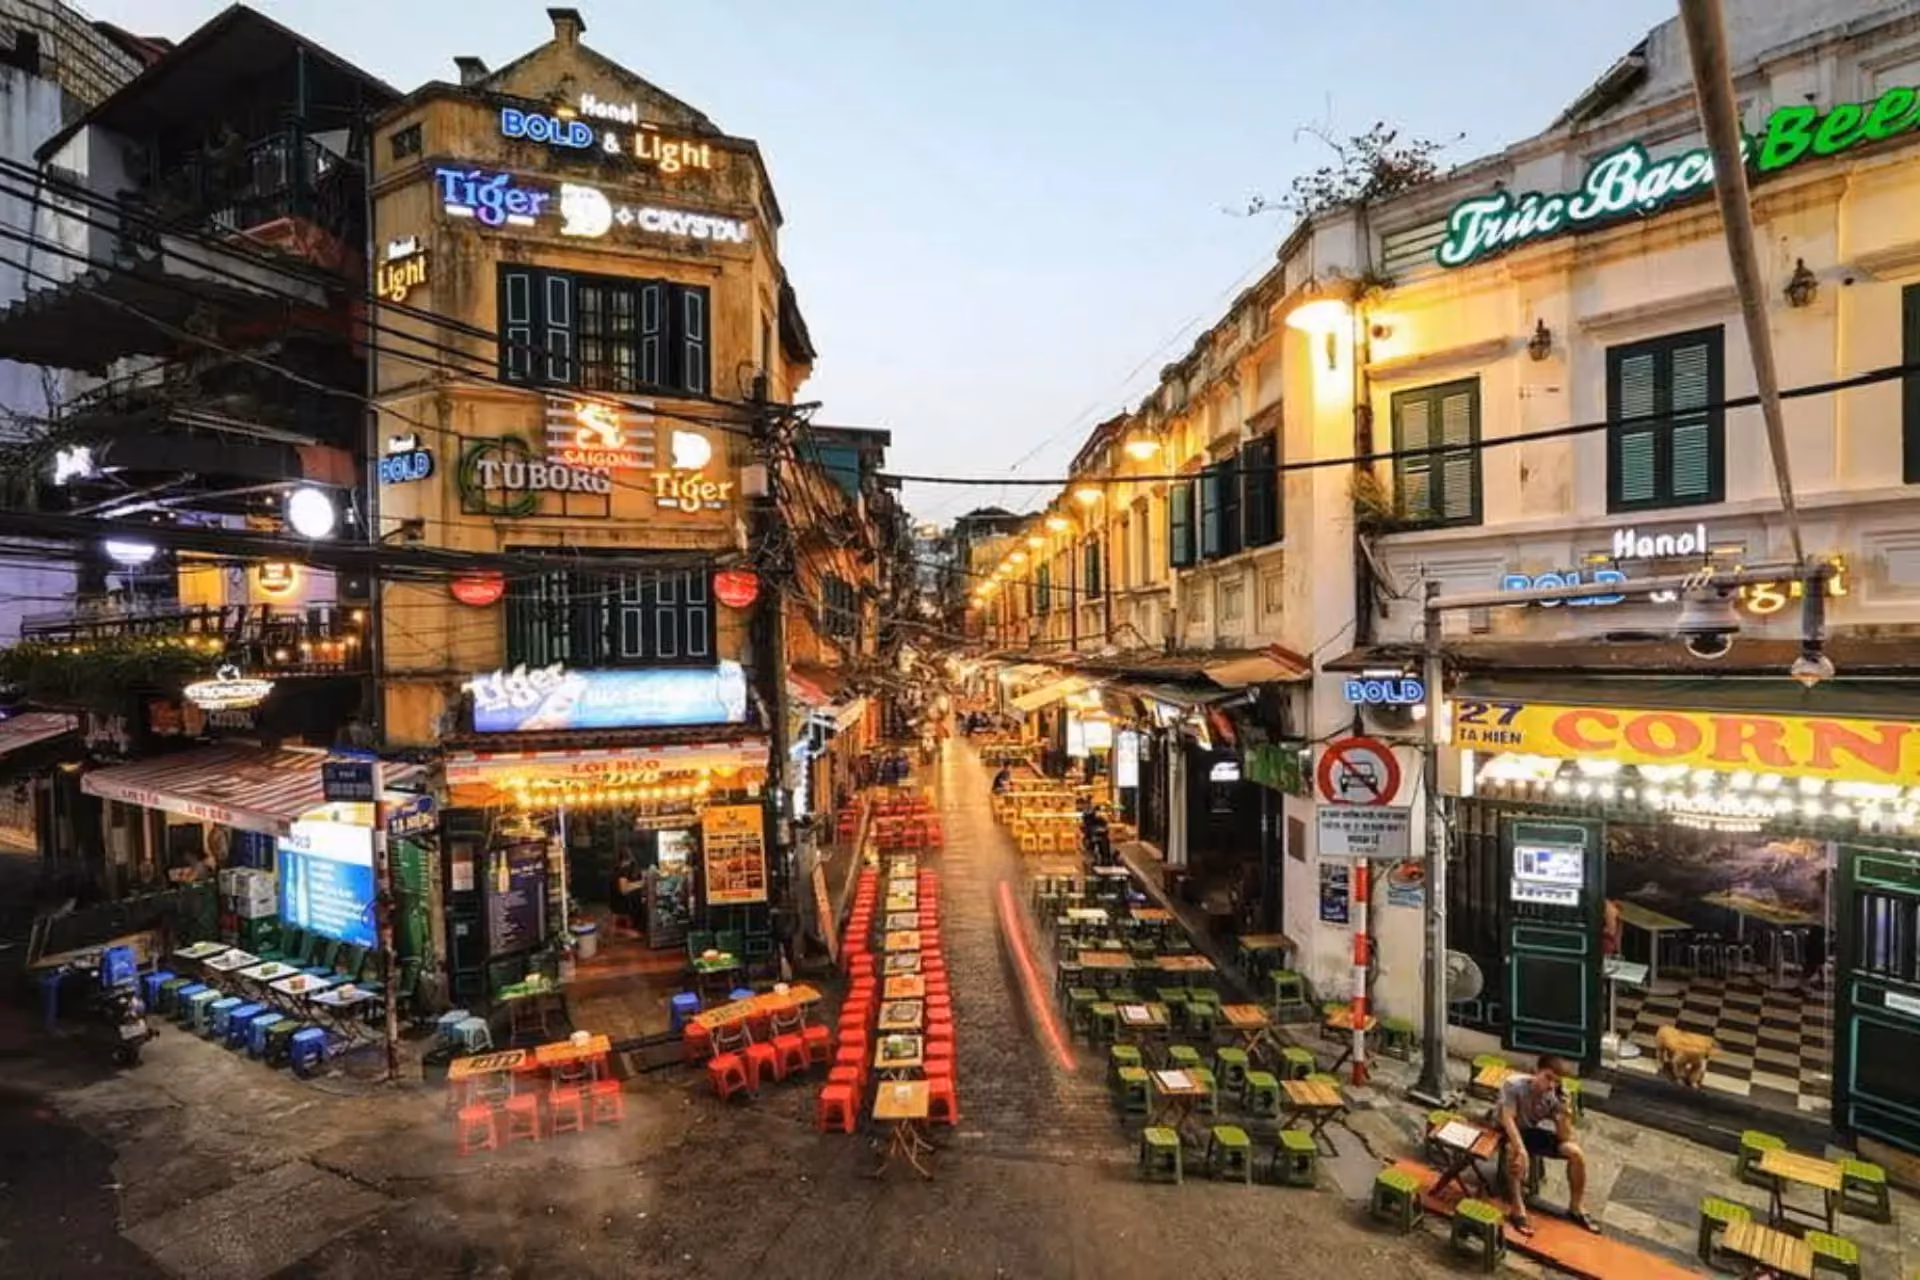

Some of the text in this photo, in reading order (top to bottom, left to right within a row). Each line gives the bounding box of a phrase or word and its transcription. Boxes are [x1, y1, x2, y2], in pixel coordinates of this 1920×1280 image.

[502, 108, 711, 173] BOLD & Light
[1441, 194, 1561, 264] Trúc
[1759, 86, 1920, 171] Bee
[435, 167, 550, 226] Tiger
[377, 254, 425, 302] Light
[378, 452, 430, 483] BOLD
[477, 459, 610, 494] TUBORG
[563, 449, 634, 467] SAIGON
[650, 471, 735, 513] Tiger
[1344, 680, 1425, 703] BOLD
[1458, 701, 1524, 725] 27
[1553, 709, 1920, 775] CORN
